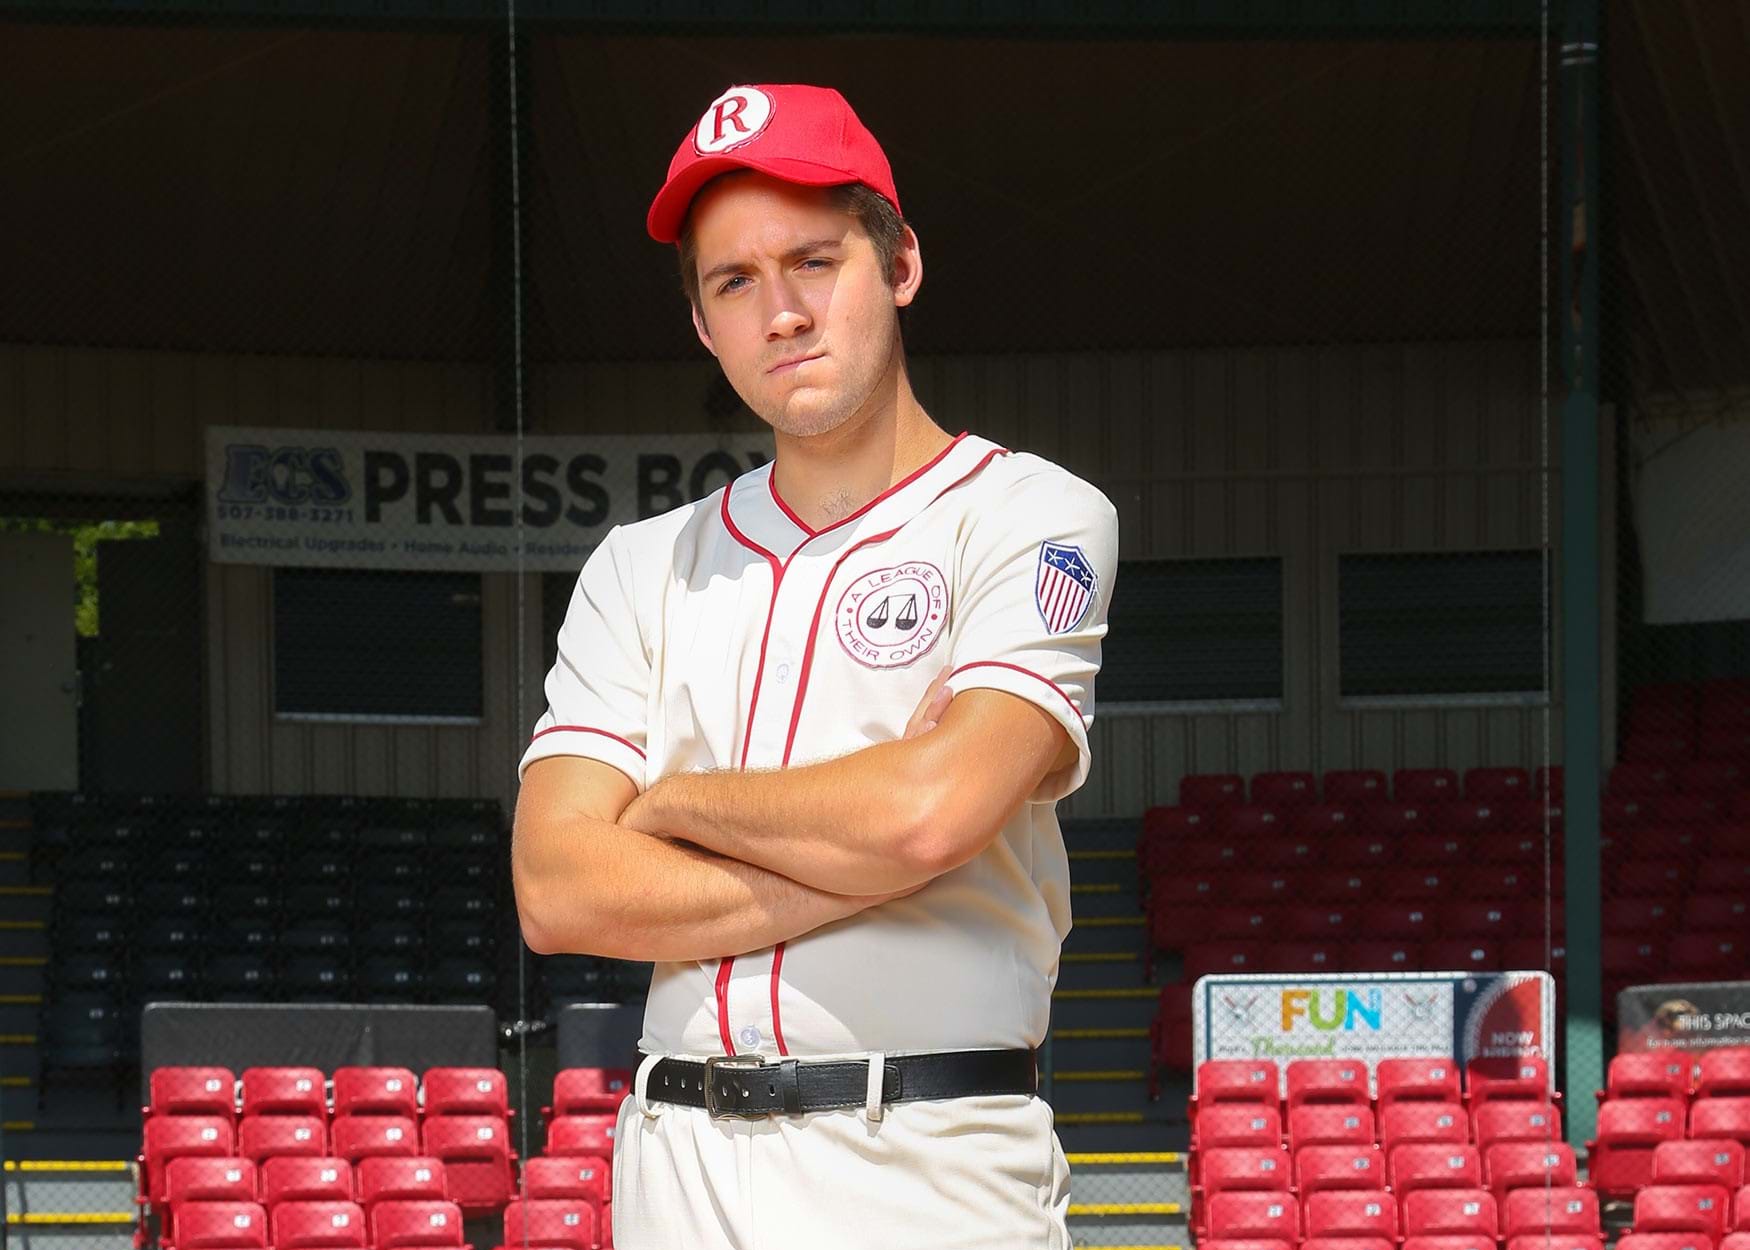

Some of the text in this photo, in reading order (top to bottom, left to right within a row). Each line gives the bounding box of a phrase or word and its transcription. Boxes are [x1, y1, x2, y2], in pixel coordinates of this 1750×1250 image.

[710, 96, 751, 145] R
[364, 451, 767, 527] PRESS BO
[222, 534, 299, 549] Electrical
[304, 537, 385, 553] Upgrades
[404, 541, 452, 554] Home
[456, 541, 507, 555] Audio
[851, 567, 942, 609] A LEAGUE OF
[842, 621, 933, 660] THEIR OWN
[1281, 988, 1382, 1031] FUN
[1679, 1013, 1712, 1031] THIS
[1491, 1031, 1534, 1047] NOW
